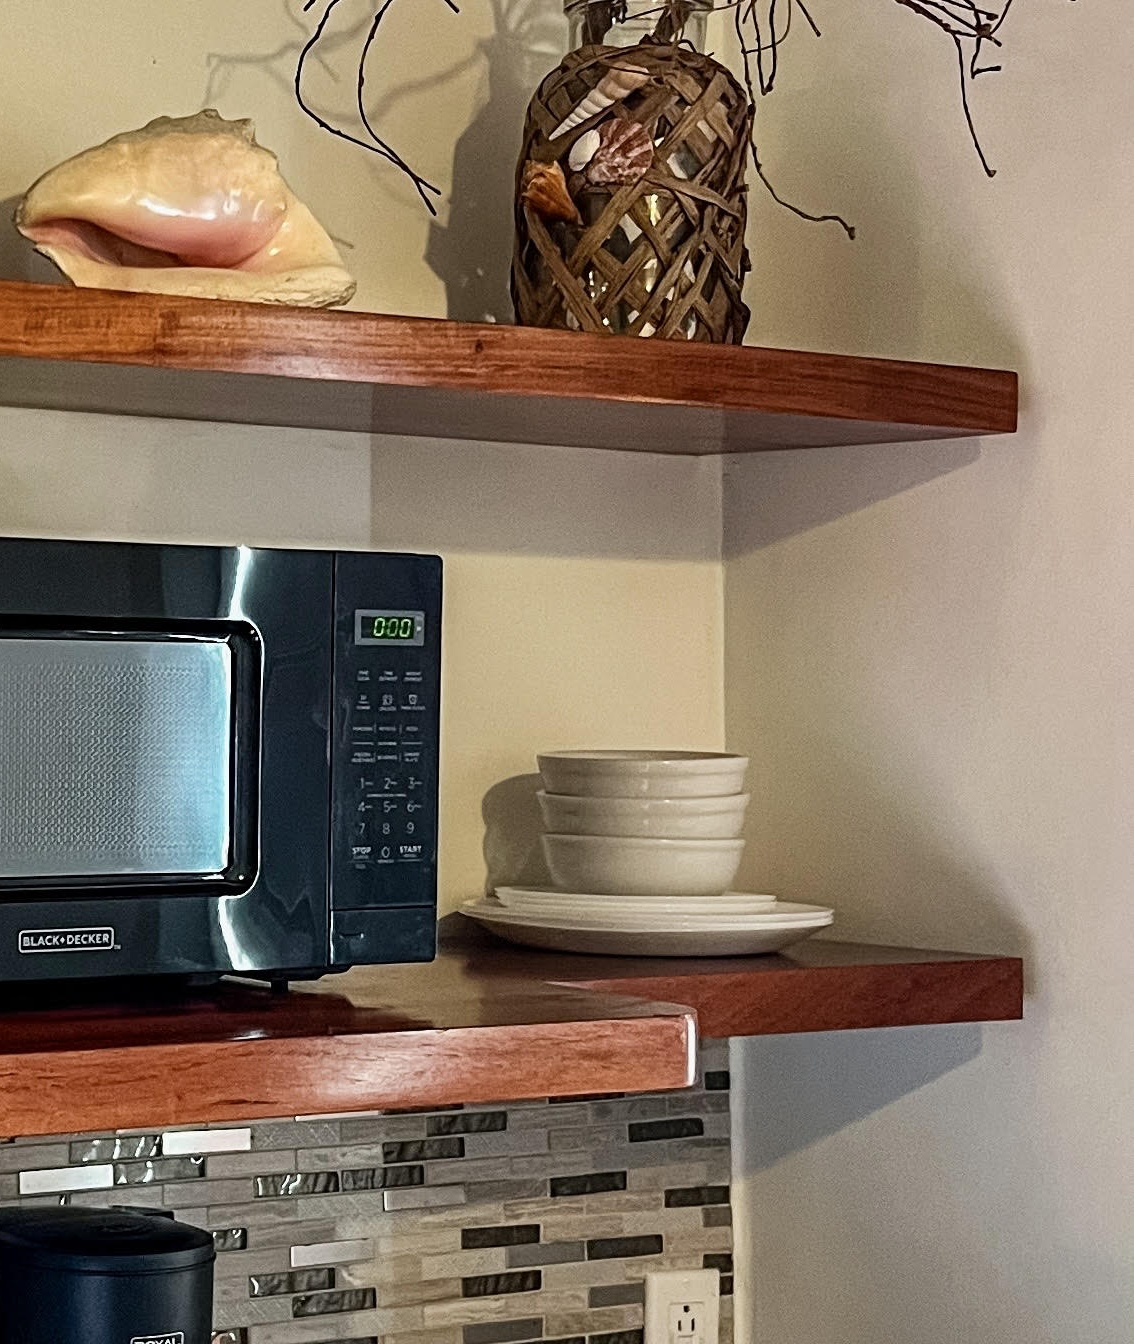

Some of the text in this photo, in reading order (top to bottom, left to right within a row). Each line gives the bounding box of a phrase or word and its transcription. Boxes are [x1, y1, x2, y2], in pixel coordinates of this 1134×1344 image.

[373, 617, 412, 638] 0:00
[384, 777, 391, 790] 2
[407, 776, 415, 790] 3
[357, 800, 415, 813] 4 5 6
[359, 821, 415, 835] 7 8 9
[352, 845, 422, 858] STOP 0 START
